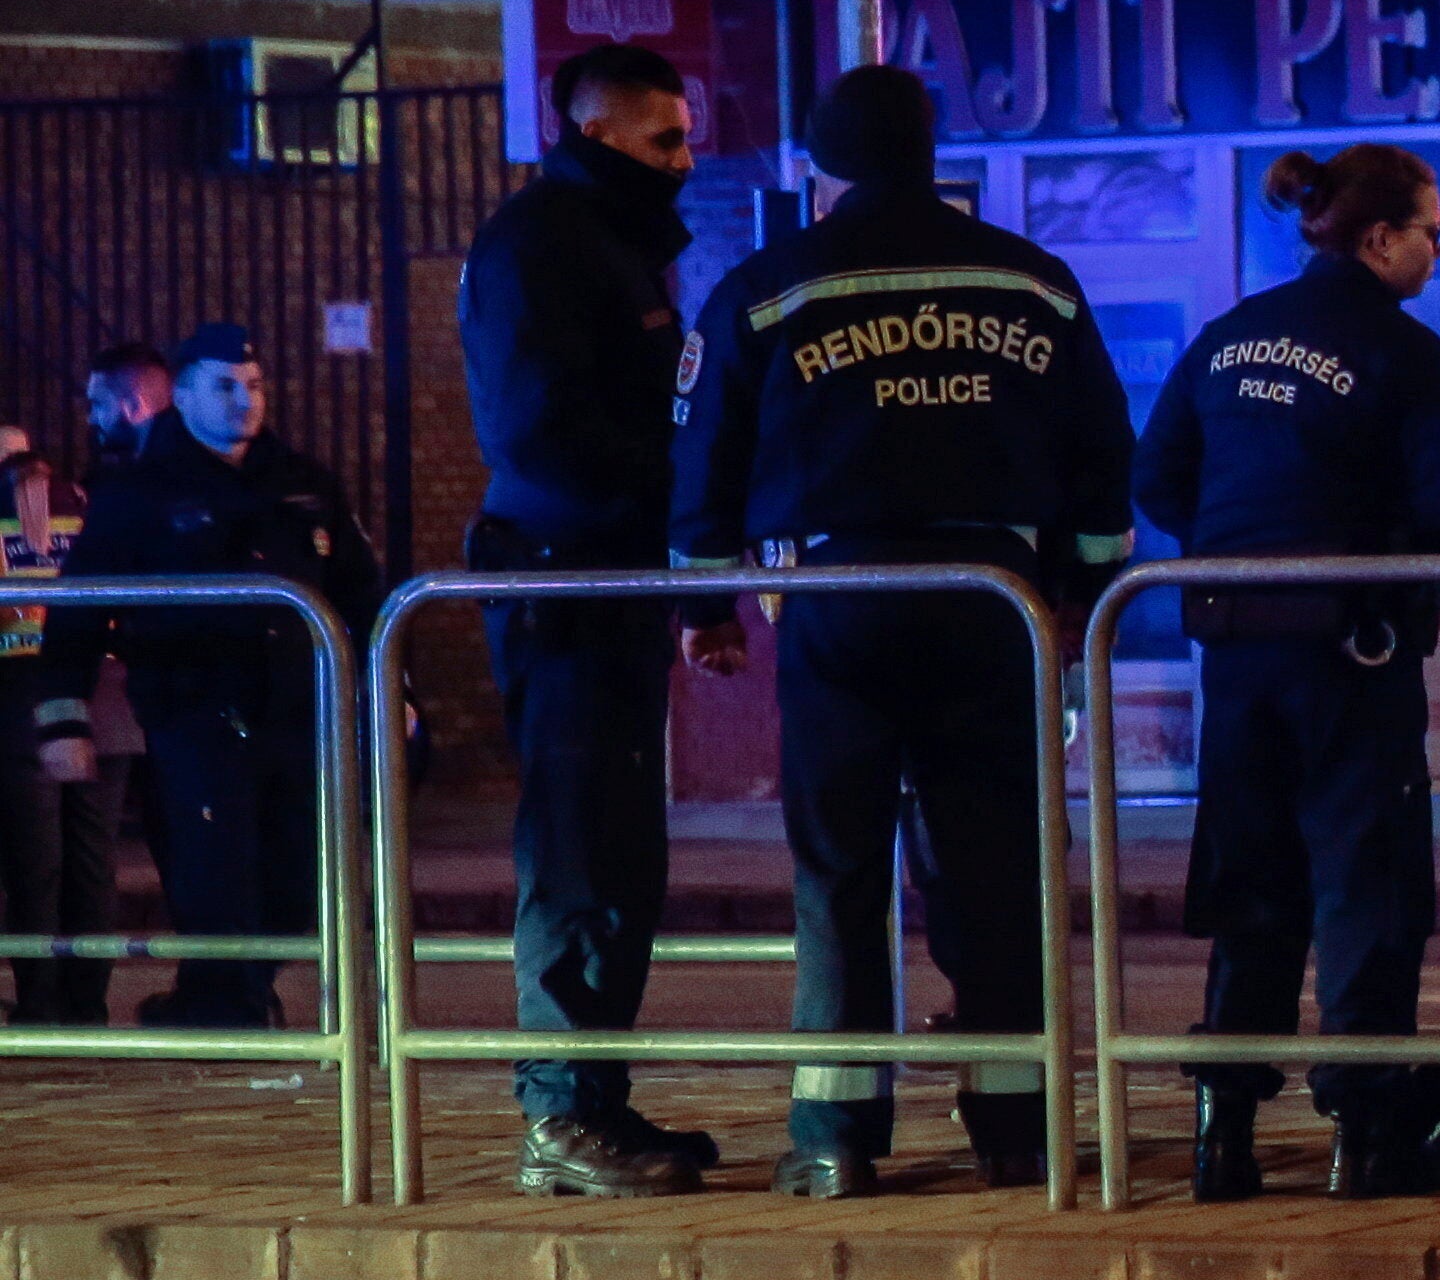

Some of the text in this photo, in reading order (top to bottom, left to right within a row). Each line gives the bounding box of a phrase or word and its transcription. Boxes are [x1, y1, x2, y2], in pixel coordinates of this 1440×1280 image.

[793, 303, 1053, 383] RENDŐRSÉG
[1210, 337, 1355, 396] RENDŐRSÉG
[875, 374, 991, 408] POLICE
[1238, 378, 1297, 405] POLICE
